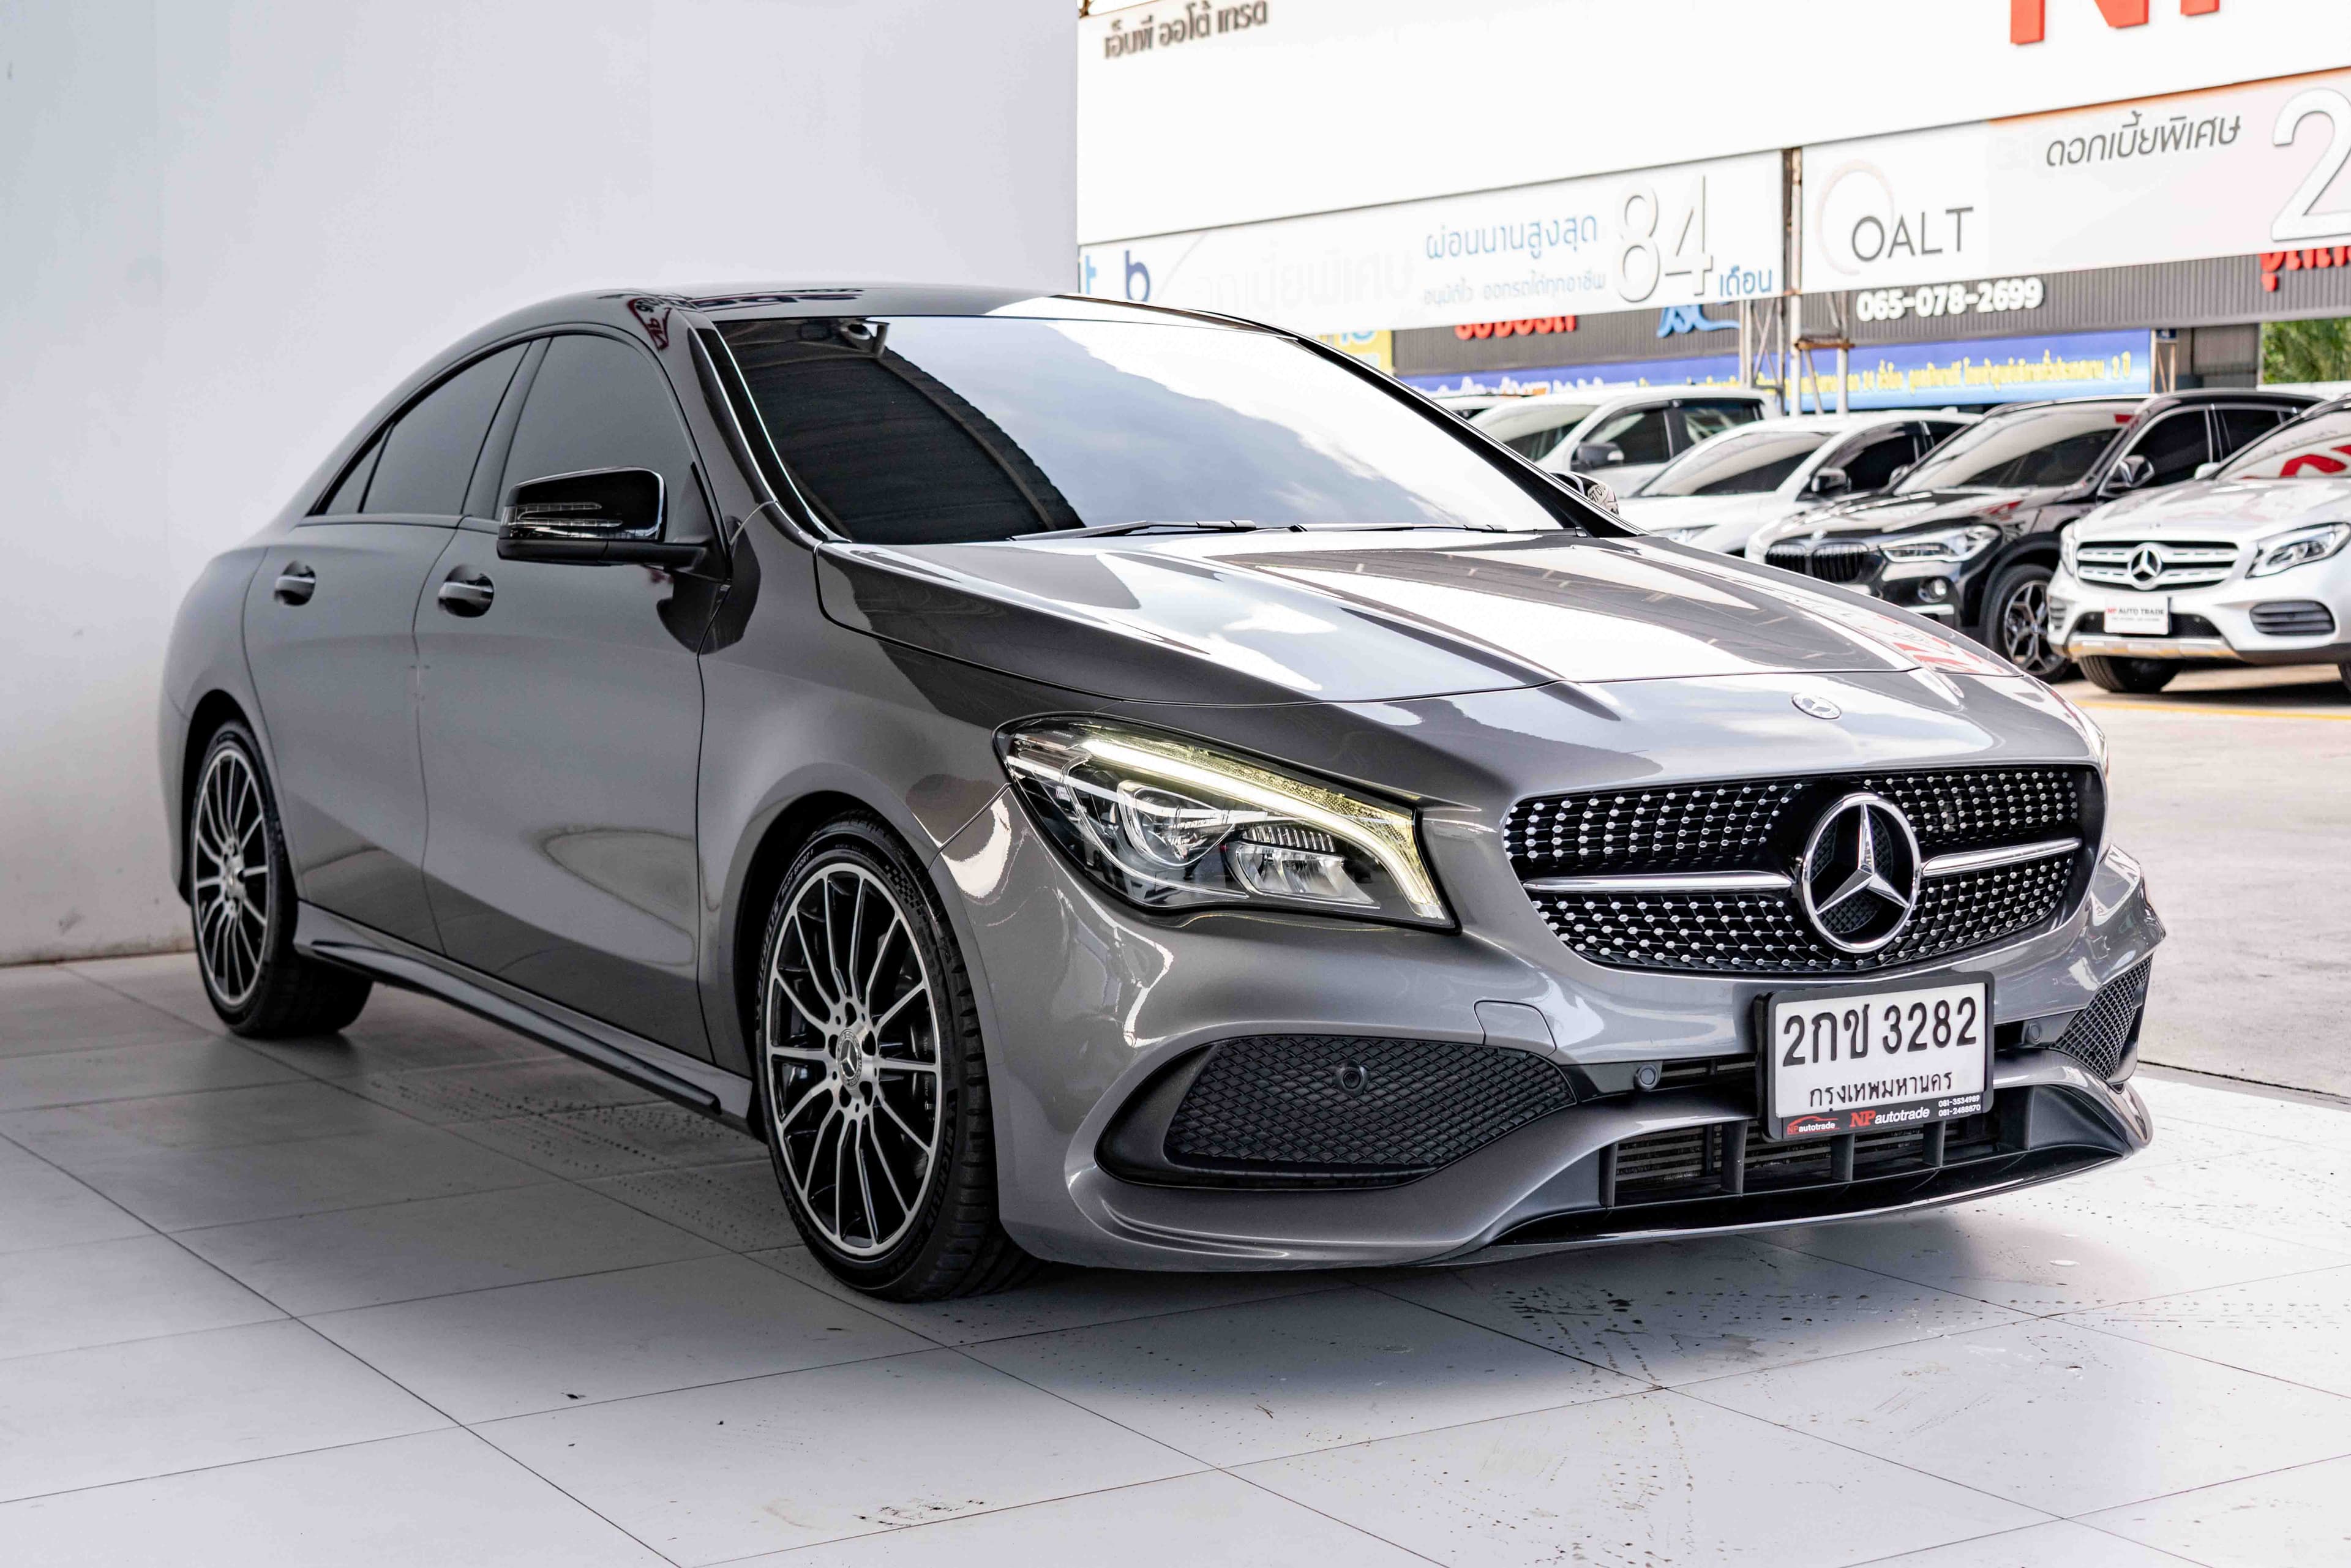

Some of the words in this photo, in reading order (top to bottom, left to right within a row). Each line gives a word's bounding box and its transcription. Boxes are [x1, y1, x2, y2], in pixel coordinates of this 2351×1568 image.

[2045, 110, 2241, 167] ดอกเบี้ยพิเศษ
[1425, 214, 1599, 259] ผ่อนนานสูงสุด
[1615, 174, 1713, 302] 84
[1719, 264, 1772, 297] เดือน
[1856, 277, 2045, 321] 065-078-2699
[1882, 996, 1976, 1055] 3282
[1809, 1071, 1953, 1112] กรุงเทพมหานคร
